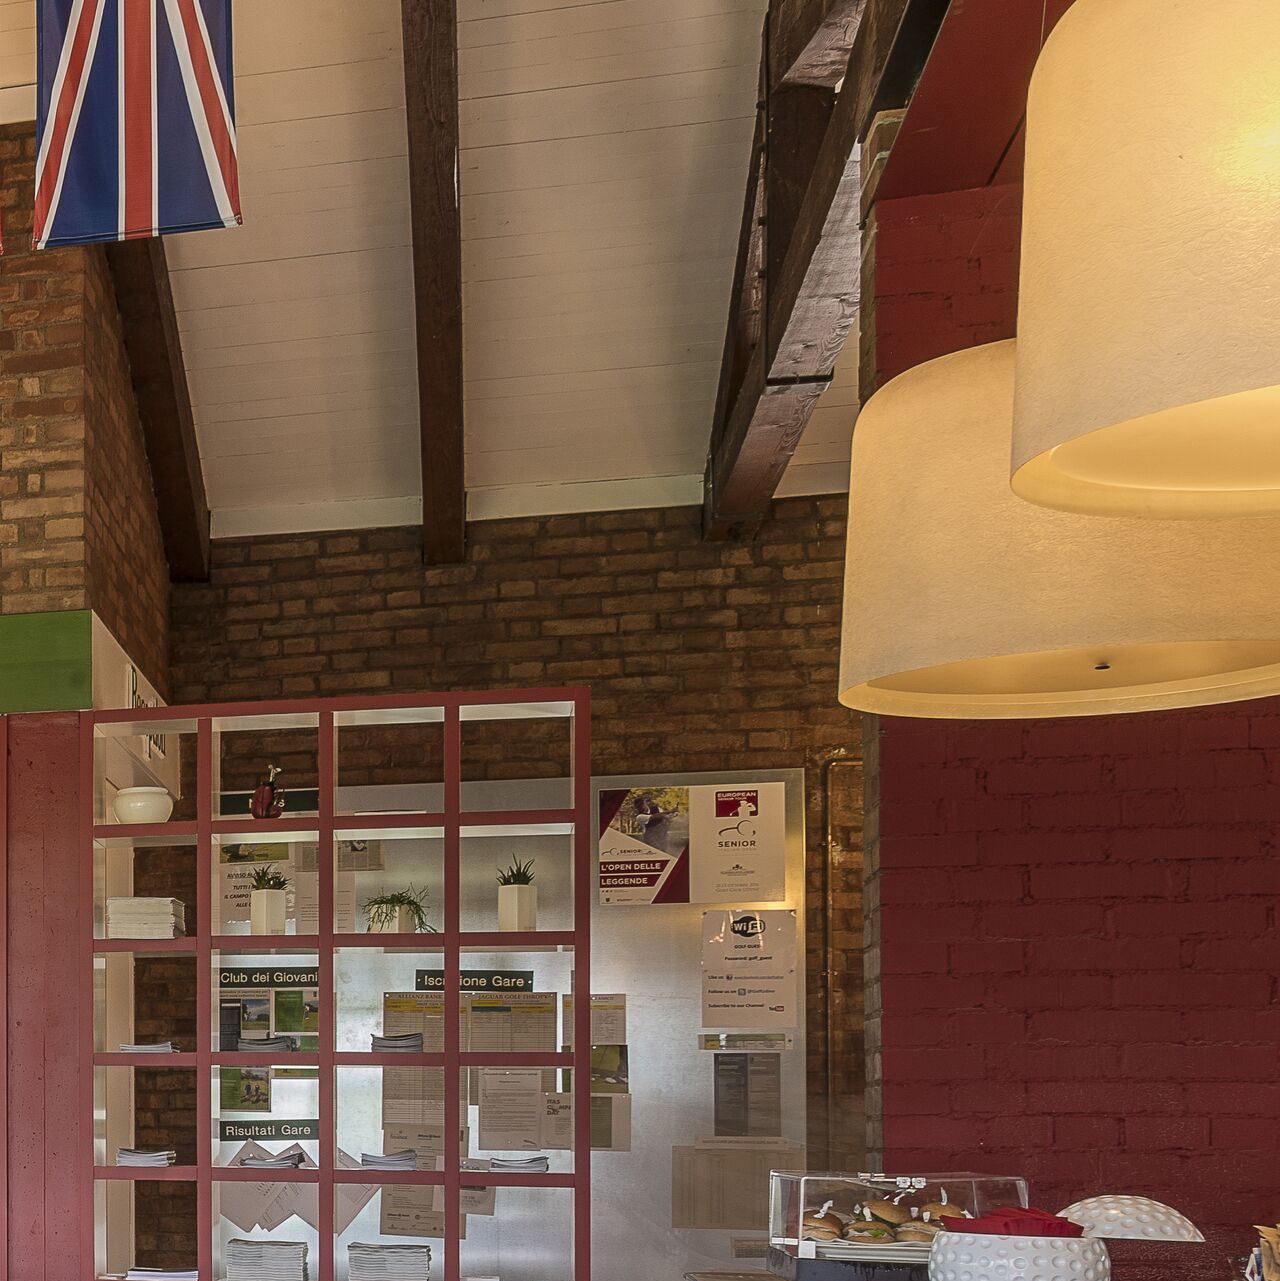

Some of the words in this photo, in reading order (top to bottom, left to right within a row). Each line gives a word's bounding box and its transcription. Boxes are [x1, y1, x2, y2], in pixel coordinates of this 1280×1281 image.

[717, 840, 756, 848] SENIOR
[601, 863, 632, 871] L'OPEN
[634, 862, 661, 870] DELLE
[601, 877, 648, 885] LEGGENDE
[221, 972, 248, 983] Club
[252, 972, 270, 982] dei
[273, 972, 318, 982] Giovani
[492, 976, 525, 987] Gare
[226, 1125, 275, 1136] Risultati
[281, 1124, 311, 1136] Gare
